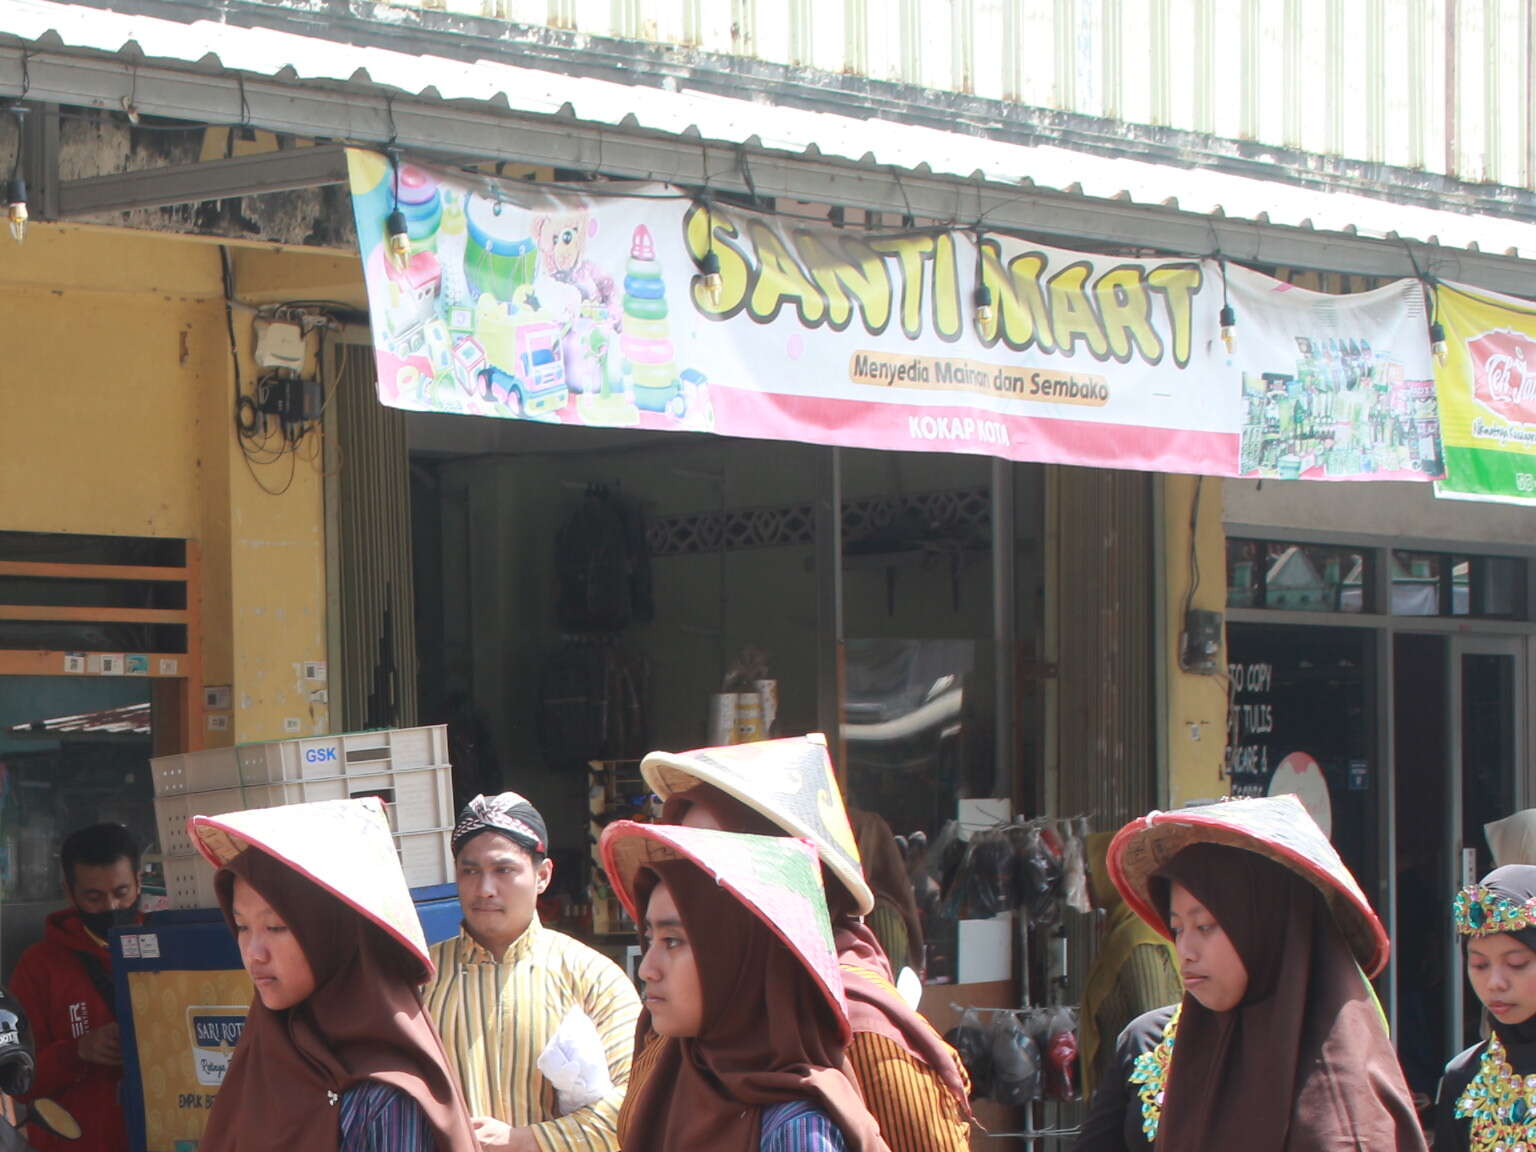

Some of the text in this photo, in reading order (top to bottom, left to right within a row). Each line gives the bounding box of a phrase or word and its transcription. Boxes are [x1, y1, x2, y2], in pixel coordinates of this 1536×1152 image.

[682, 198, 1203, 369] SANTI MART
[853, 353, 1109, 401] Menyedia Mainan dan Sembako
[908, 415, 1011, 447] KOKAP KOTA
[1246, 663, 1272, 693] COPY
[1243, 703, 1273, 733] TULIS
[305, 746, 337, 764] GSK
[197, 1022, 245, 1042] SARI ROT
